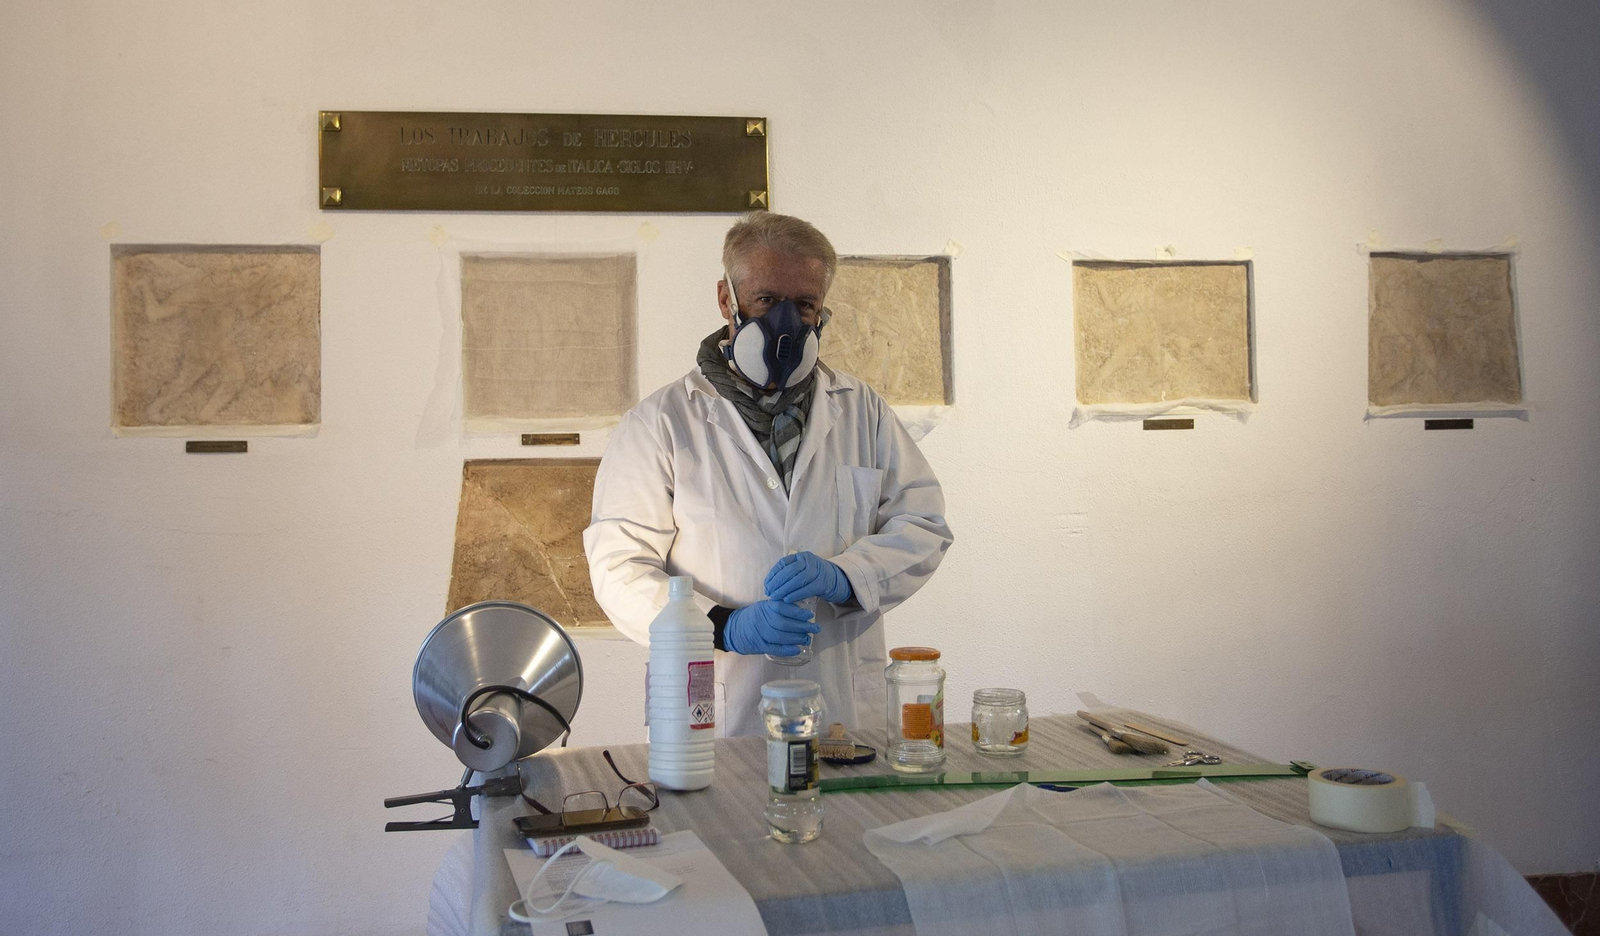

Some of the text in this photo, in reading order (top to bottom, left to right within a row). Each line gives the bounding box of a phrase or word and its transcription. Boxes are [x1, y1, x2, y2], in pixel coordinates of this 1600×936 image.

[400, 127, 692, 148] LOS TRABAJOS DE HERCULES
[401, 157, 459, 173] METOPAS
[464, 158, 554, 174] PROCEDENTES
[567, 159, 614, 174] ITALICA
[490, 186, 502, 195] LA
[557, 186, 594, 196] MATEOS
[595, 186, 620, 196] GAGO
